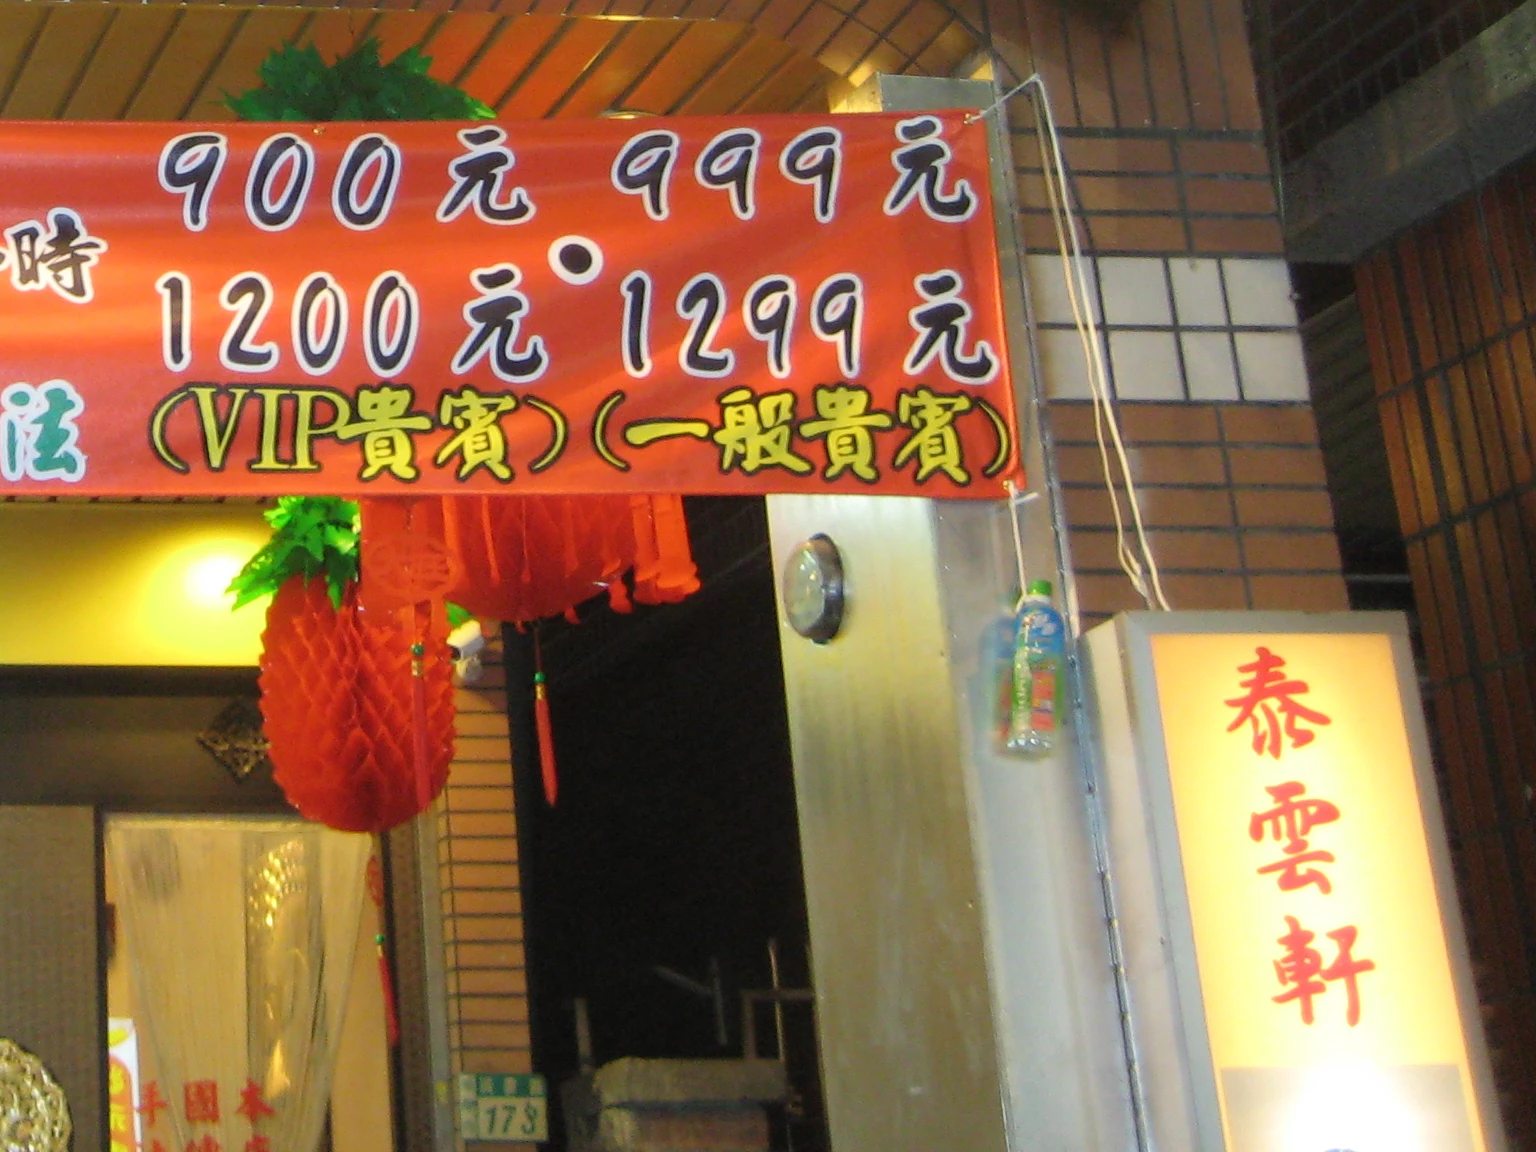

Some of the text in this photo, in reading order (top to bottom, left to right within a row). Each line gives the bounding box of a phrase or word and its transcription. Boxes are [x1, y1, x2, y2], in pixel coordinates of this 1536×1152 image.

[158, 123, 537, 232] 900元
[611, 115, 979, 223] 999元
[154, 261, 550, 385] 1200元
[618, 268, 1001, 386] 1299元
[1224, 645, 1377, 1028] 泰雲軒
